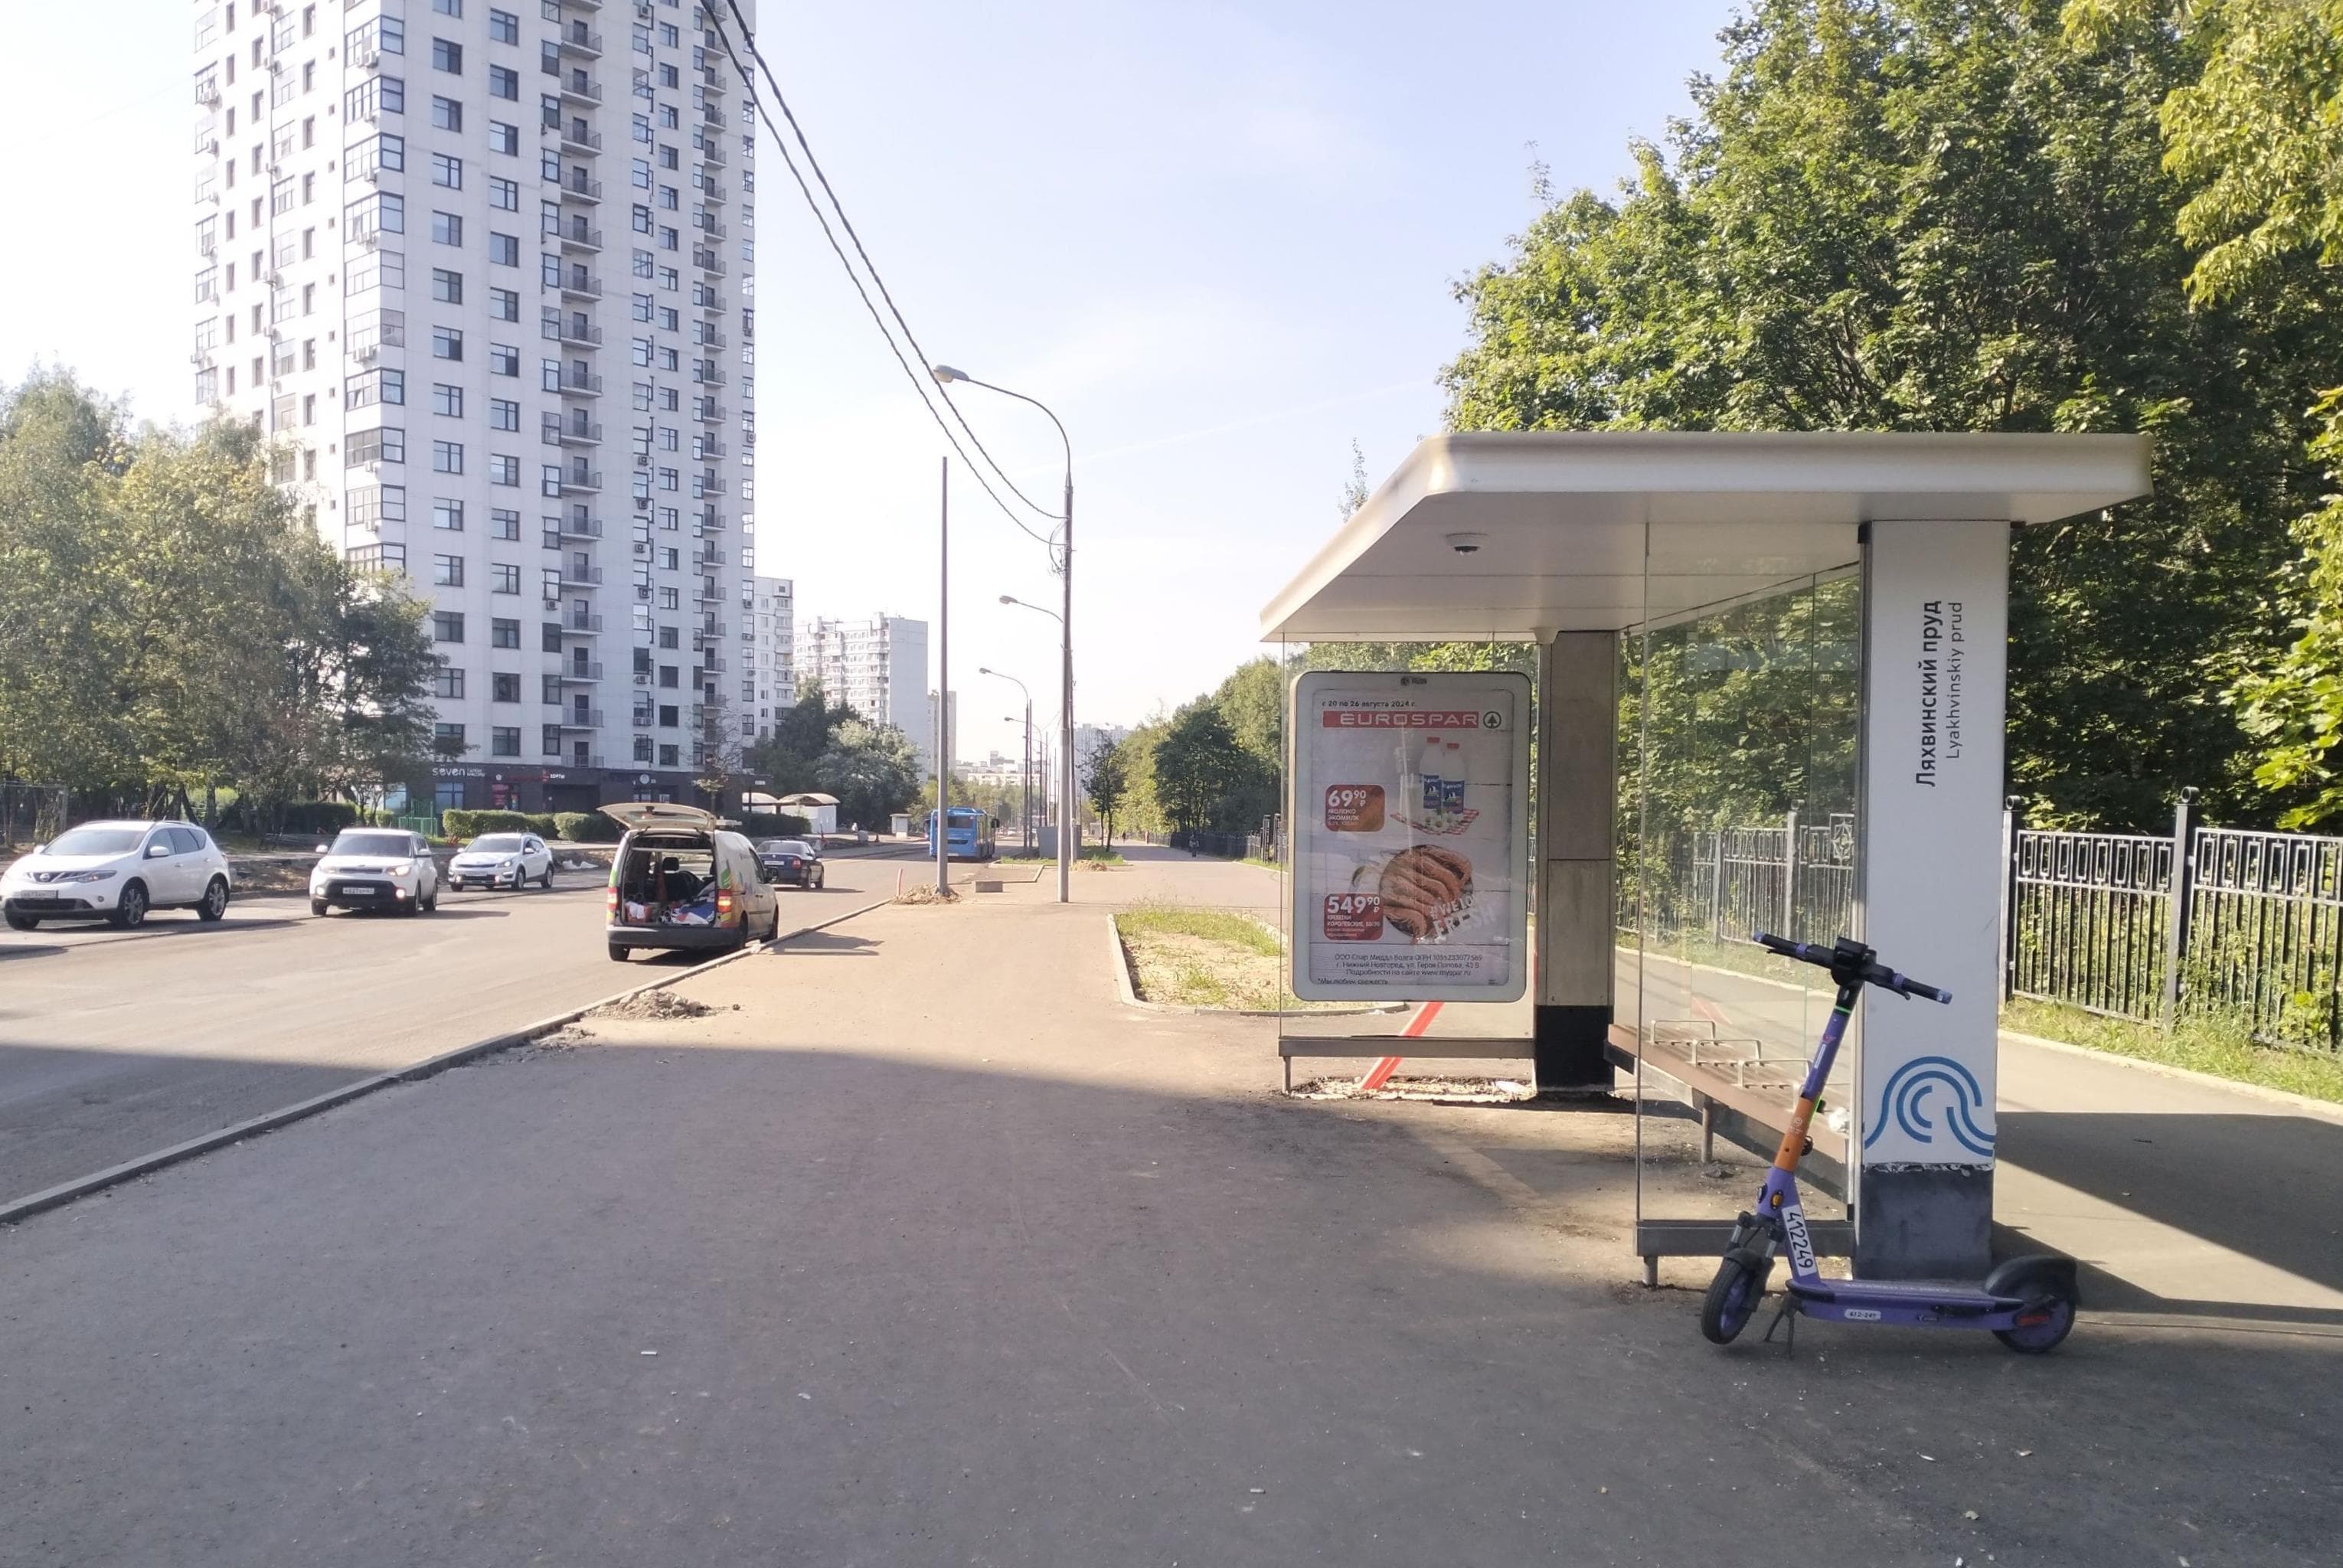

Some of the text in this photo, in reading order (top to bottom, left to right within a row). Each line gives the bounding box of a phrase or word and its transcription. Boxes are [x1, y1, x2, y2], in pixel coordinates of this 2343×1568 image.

[1916, 601, 1943, 787] Ляхвинский пруд
[1946, 603, 1964, 759] Lyakhvinskiy prud
[1340, 714, 1477, 725] EUROSPAR
[432, 766, 465, 777] seven
[1787, 1212, 1813, 1269] 412249
